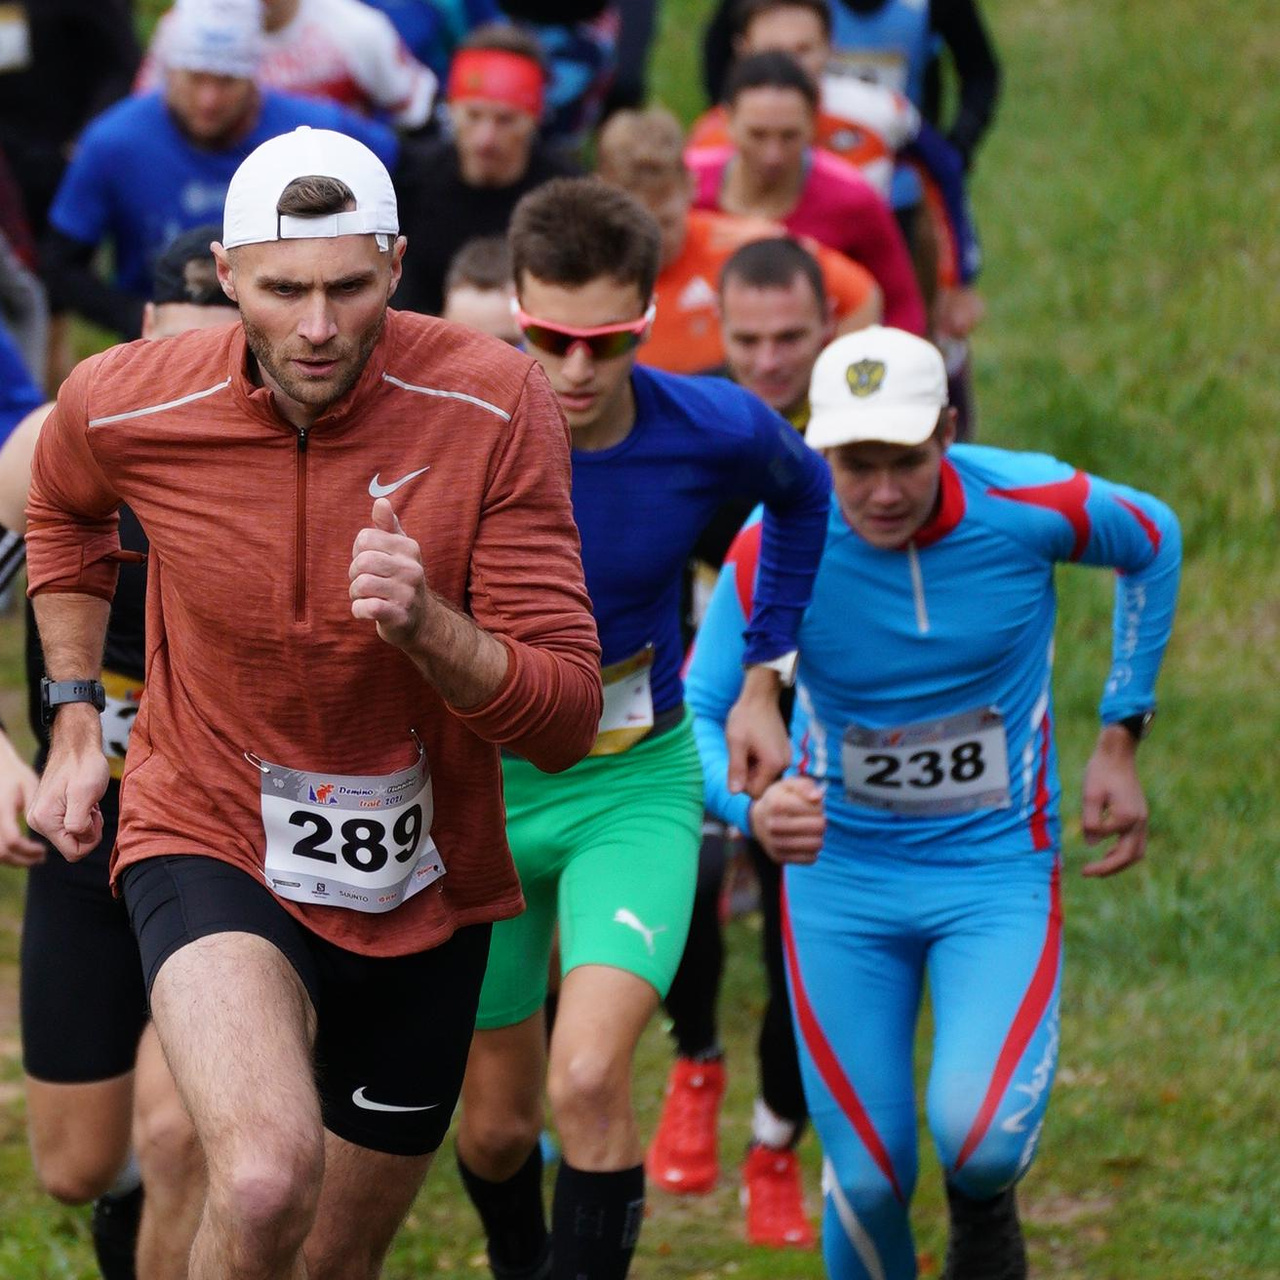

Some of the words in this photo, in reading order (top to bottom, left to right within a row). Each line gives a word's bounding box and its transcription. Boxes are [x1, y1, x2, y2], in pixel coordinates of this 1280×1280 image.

[863, 740, 986, 789] 238
[338, 786, 374, 796] Demino
[288, 803, 422, 873] 289
[339, 890, 369, 902] SUUNTO
